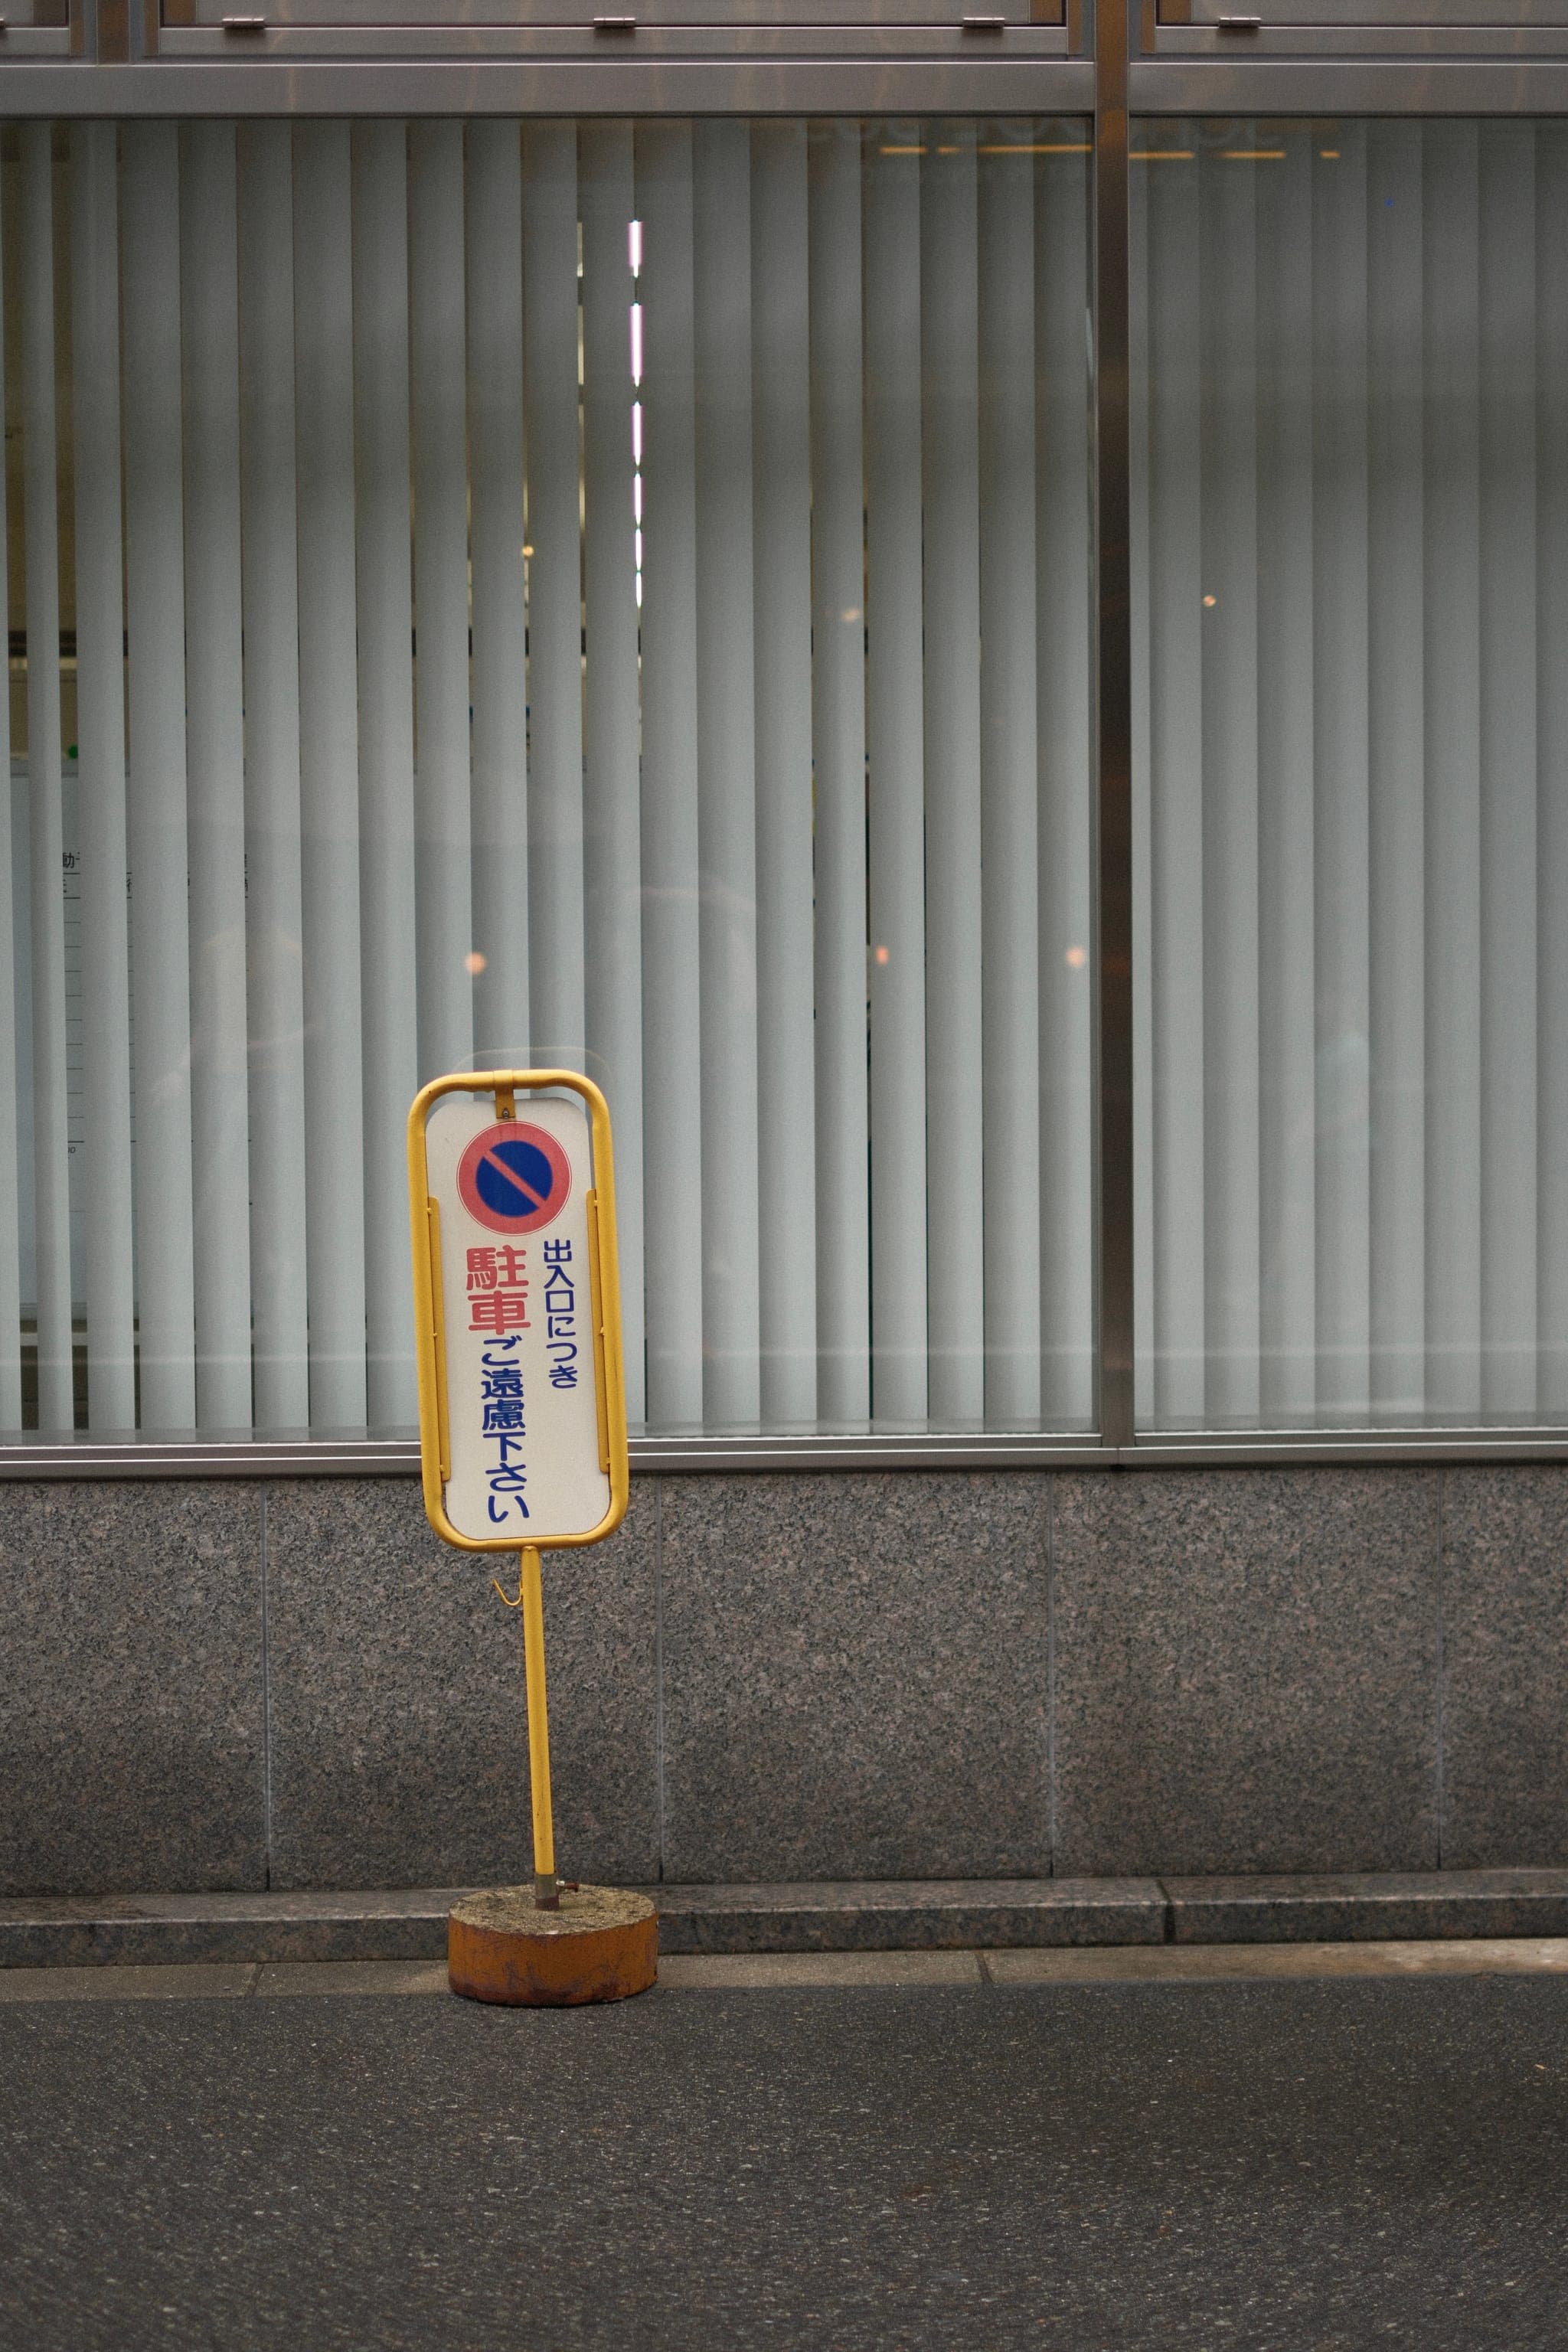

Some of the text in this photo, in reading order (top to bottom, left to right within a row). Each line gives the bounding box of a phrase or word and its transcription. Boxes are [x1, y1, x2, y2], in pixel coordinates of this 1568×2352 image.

[465, 1244, 531, 1524] 駐車ご遠慮下さい
[543, 1239, 578, 1390] 出入口につき
